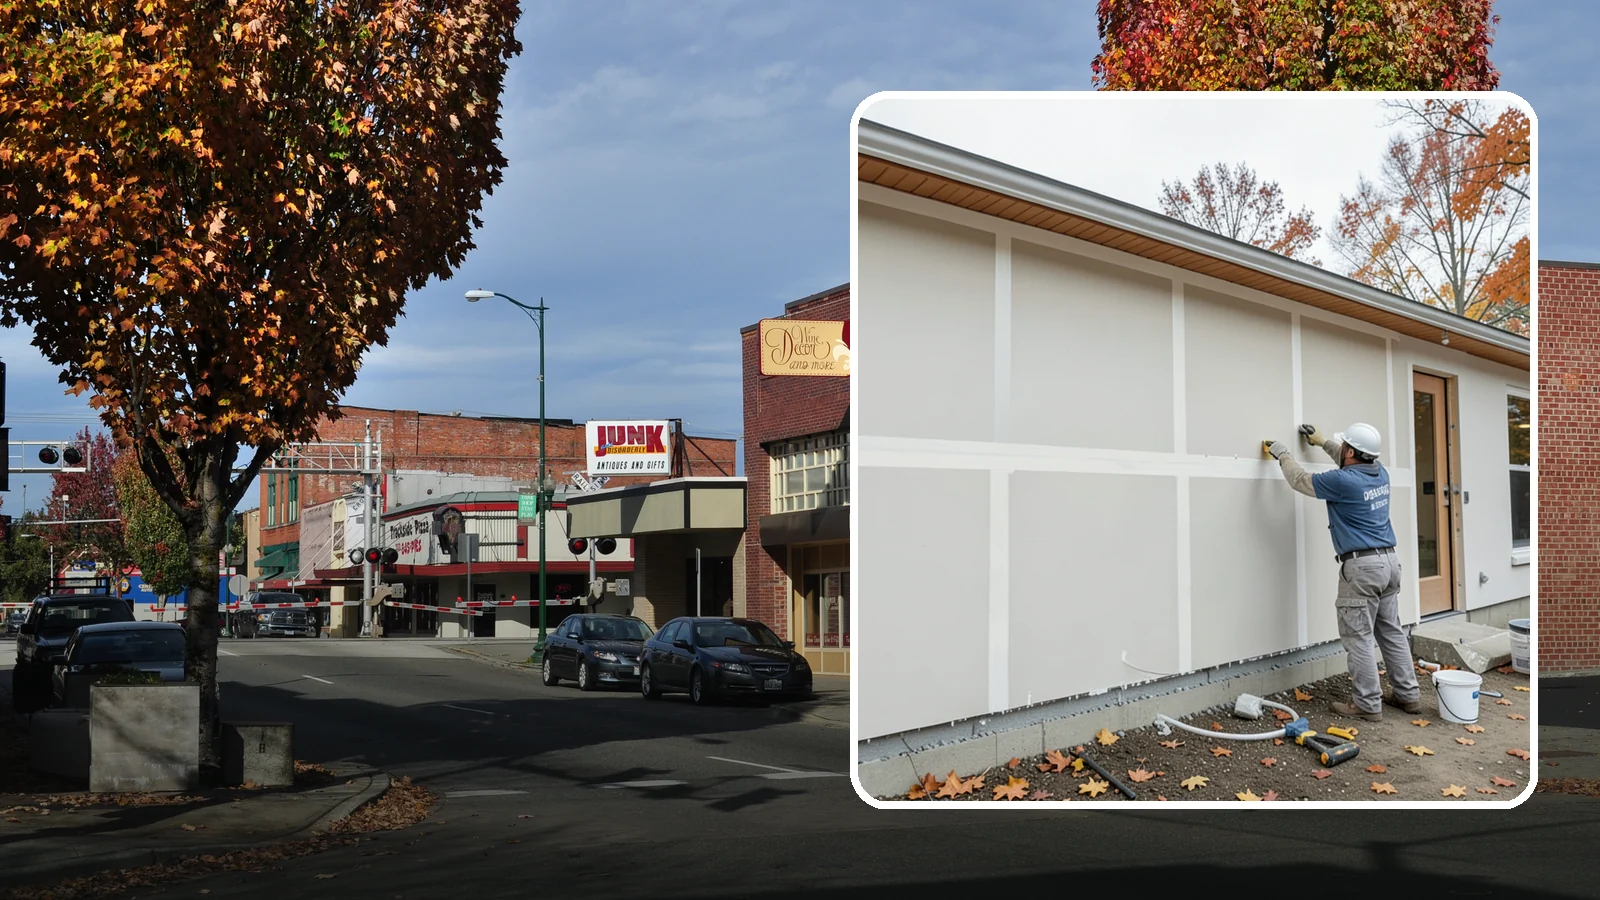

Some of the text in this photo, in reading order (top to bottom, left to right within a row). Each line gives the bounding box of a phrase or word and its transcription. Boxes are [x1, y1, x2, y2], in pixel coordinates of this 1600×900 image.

[596, 426, 664, 457] JUNK
[597, 460, 666, 470] ANTIQUES AND GIFTS
[414, 519, 429, 535] Pizza
